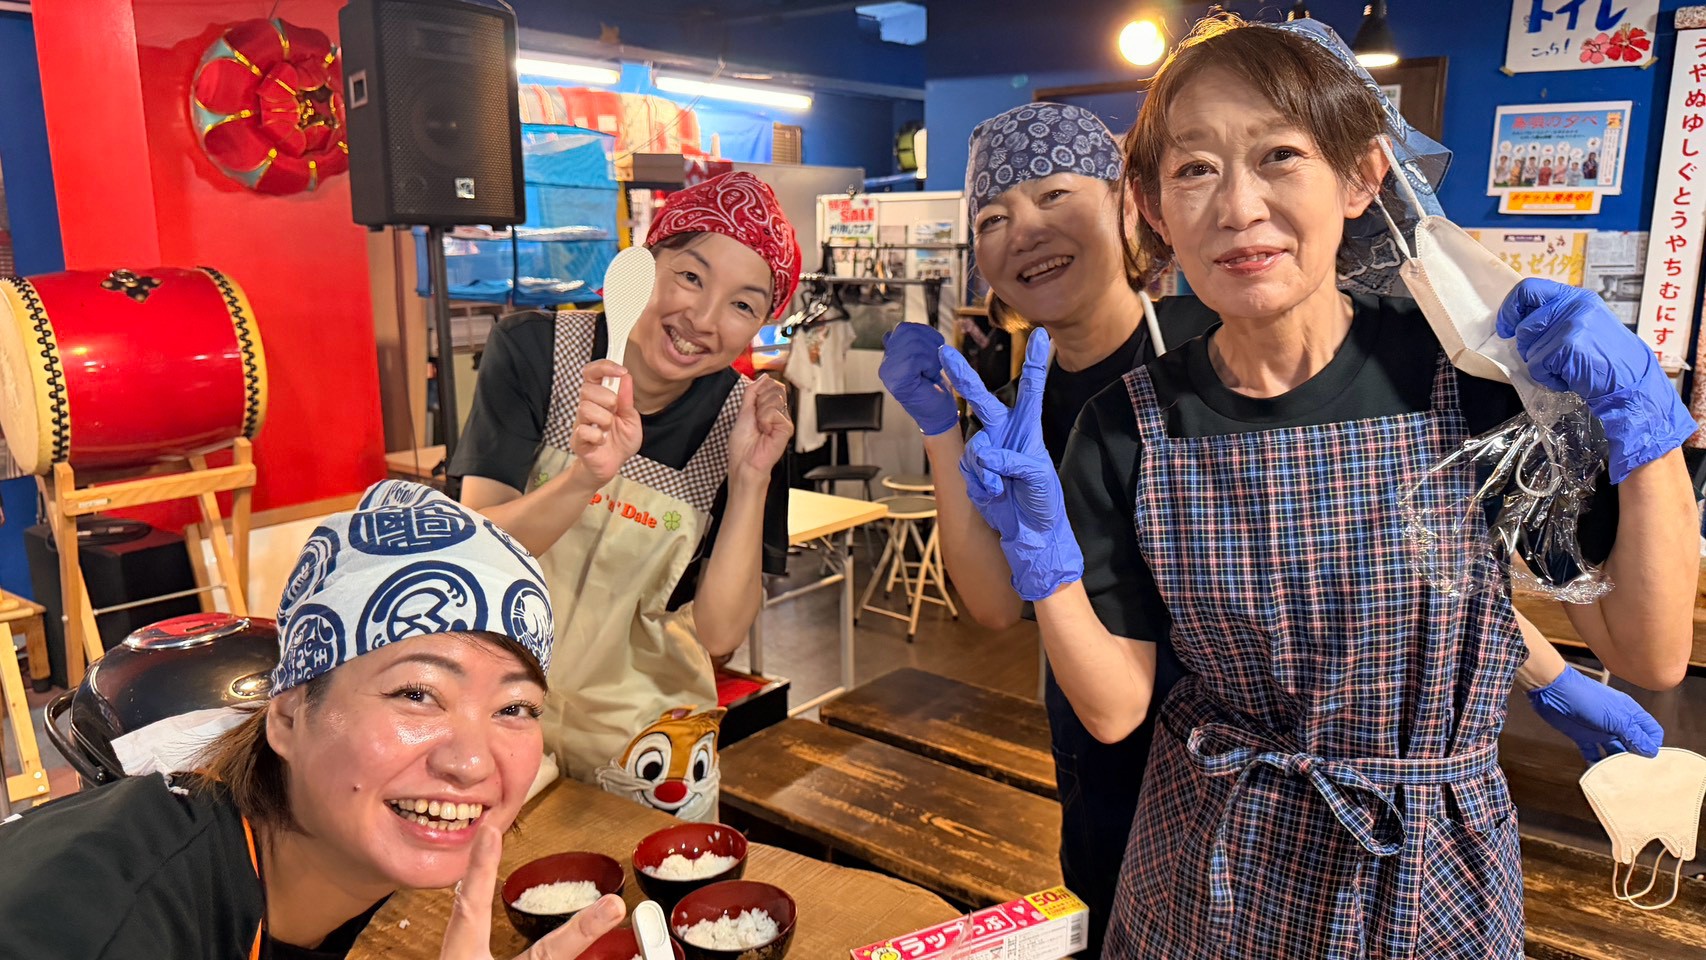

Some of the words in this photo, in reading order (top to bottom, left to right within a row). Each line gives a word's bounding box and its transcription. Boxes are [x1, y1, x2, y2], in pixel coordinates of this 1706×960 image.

[1527, 0, 1628, 33] トイレ
[841, 207, 874, 224] SALE
[621, 503, 658, 529] Dale
